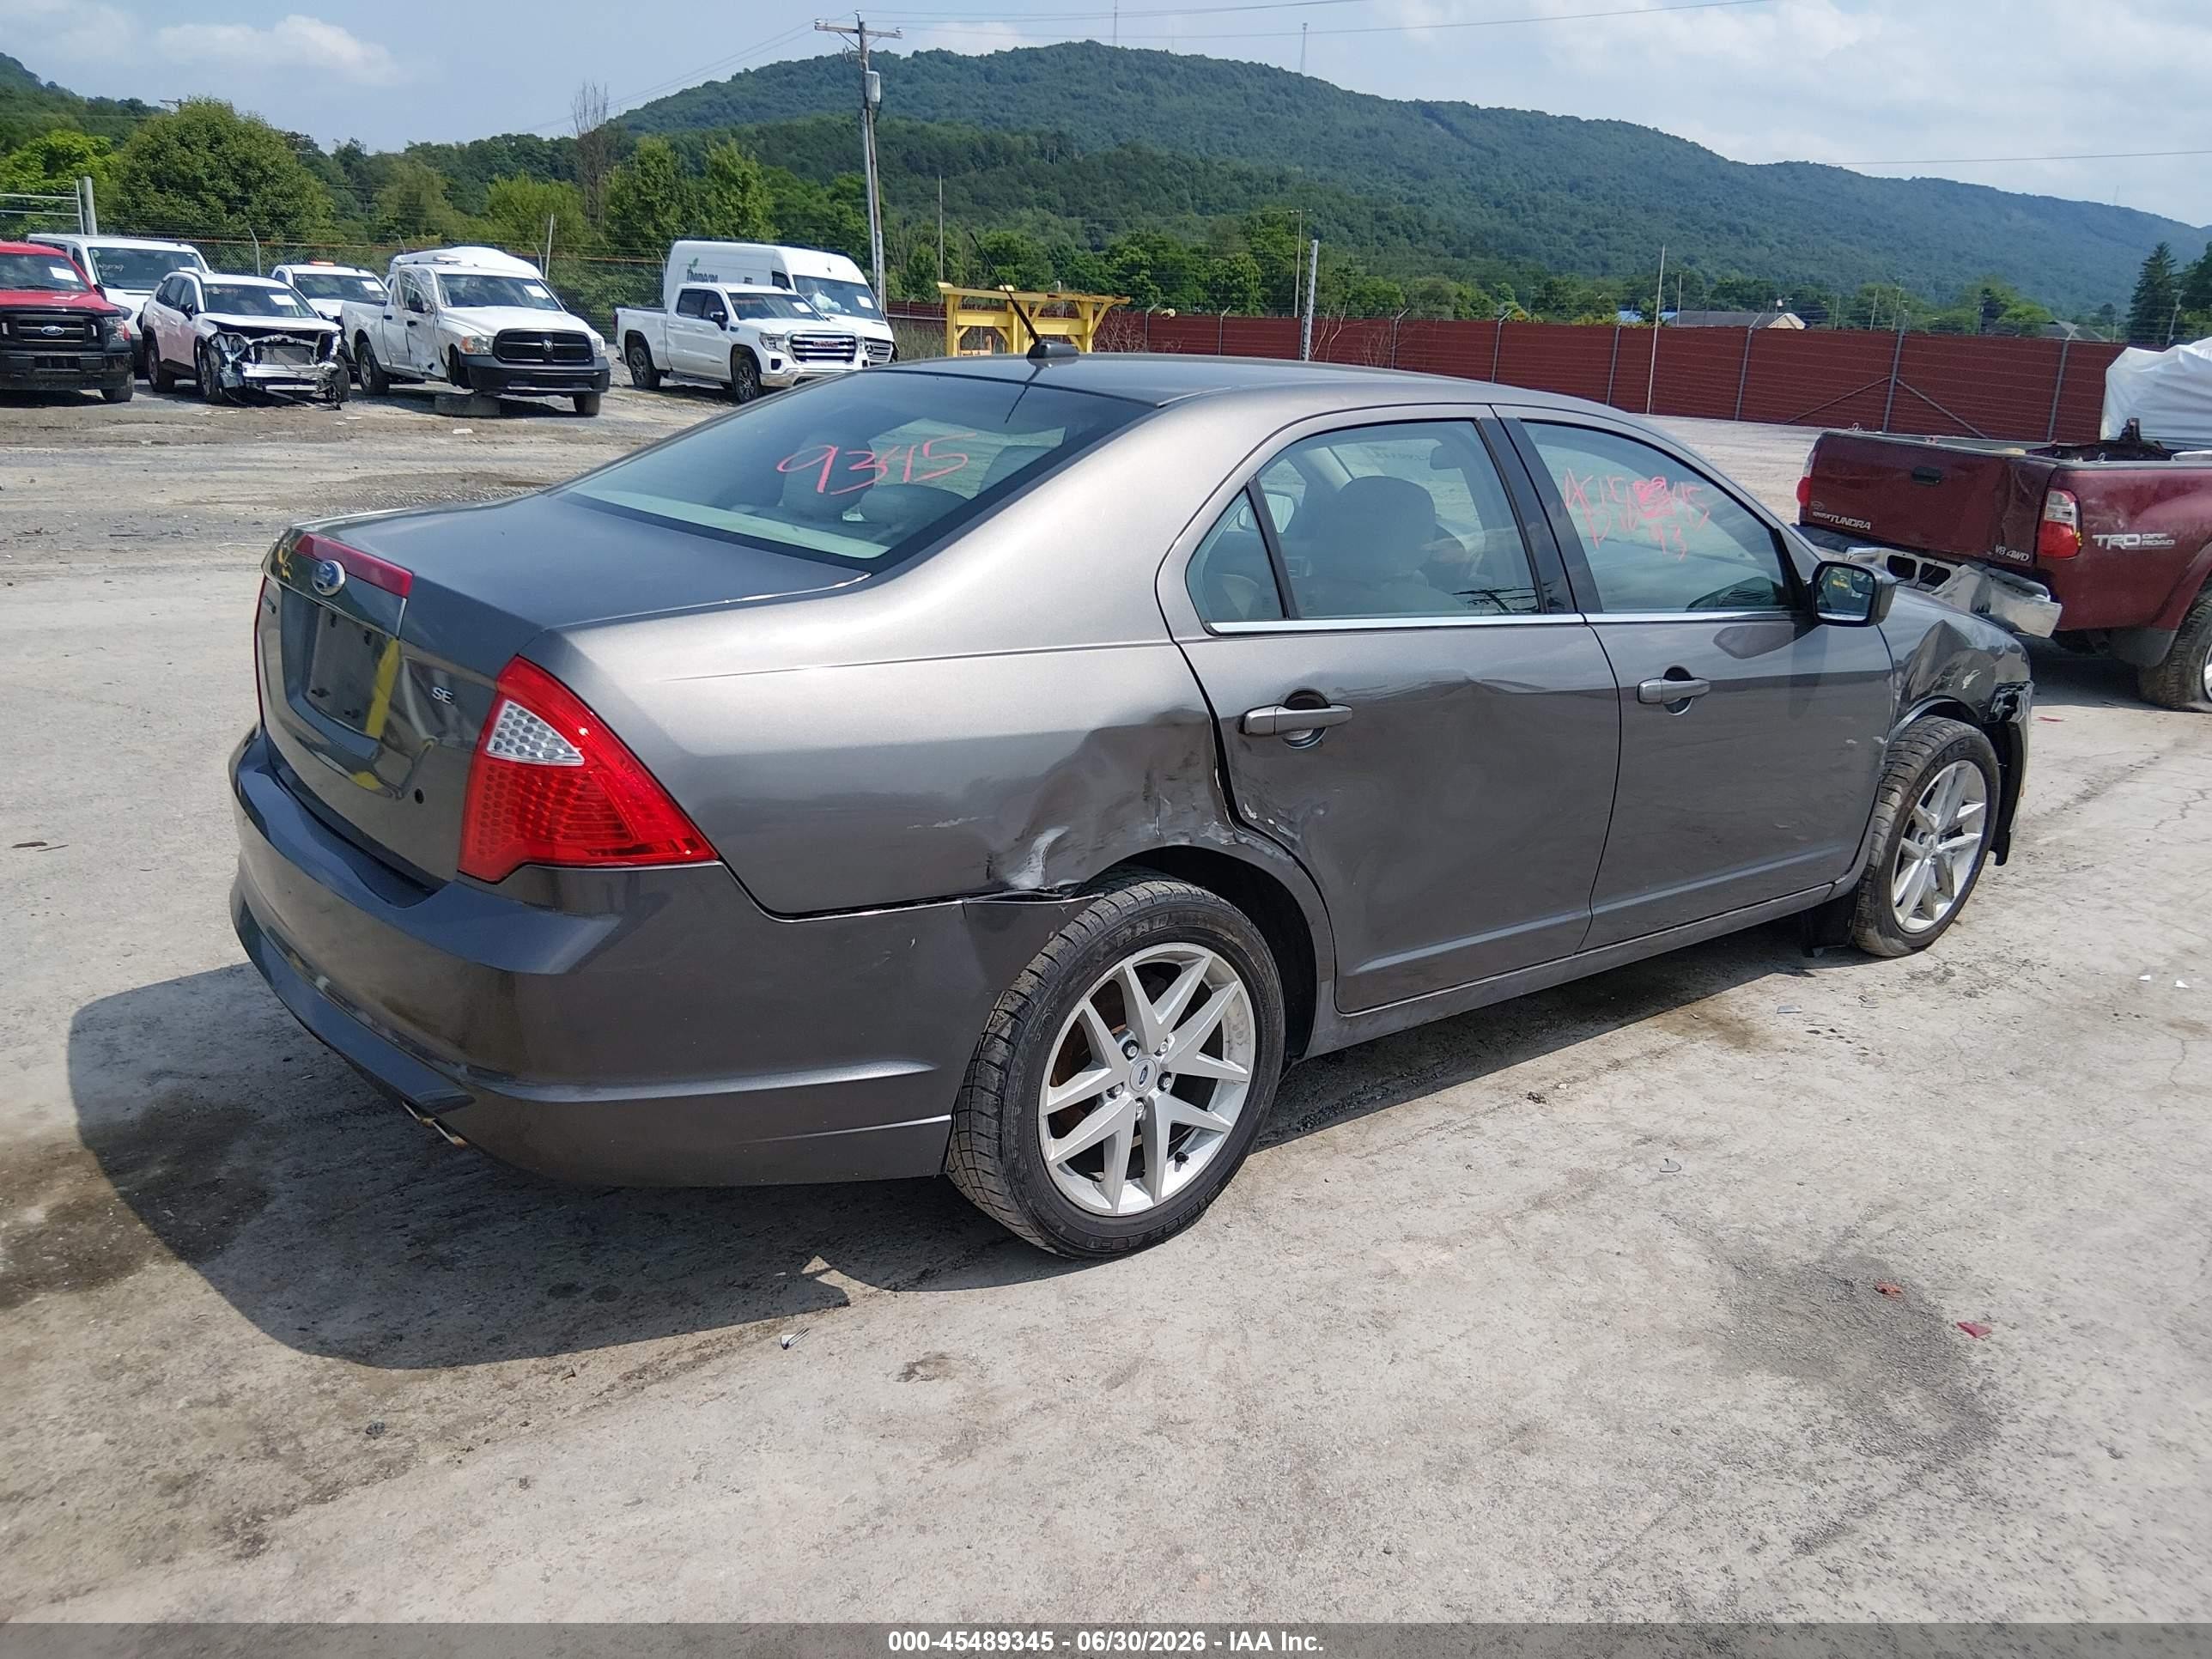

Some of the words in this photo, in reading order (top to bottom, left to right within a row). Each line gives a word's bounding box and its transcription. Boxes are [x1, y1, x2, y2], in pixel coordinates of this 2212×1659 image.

[1826, 514, 1871, 530] TUNDRA
[2092, 533, 2141, 550] TRD
[2006, 550, 2030, 562] 4WD
[432, 686, 454, 704] SE
